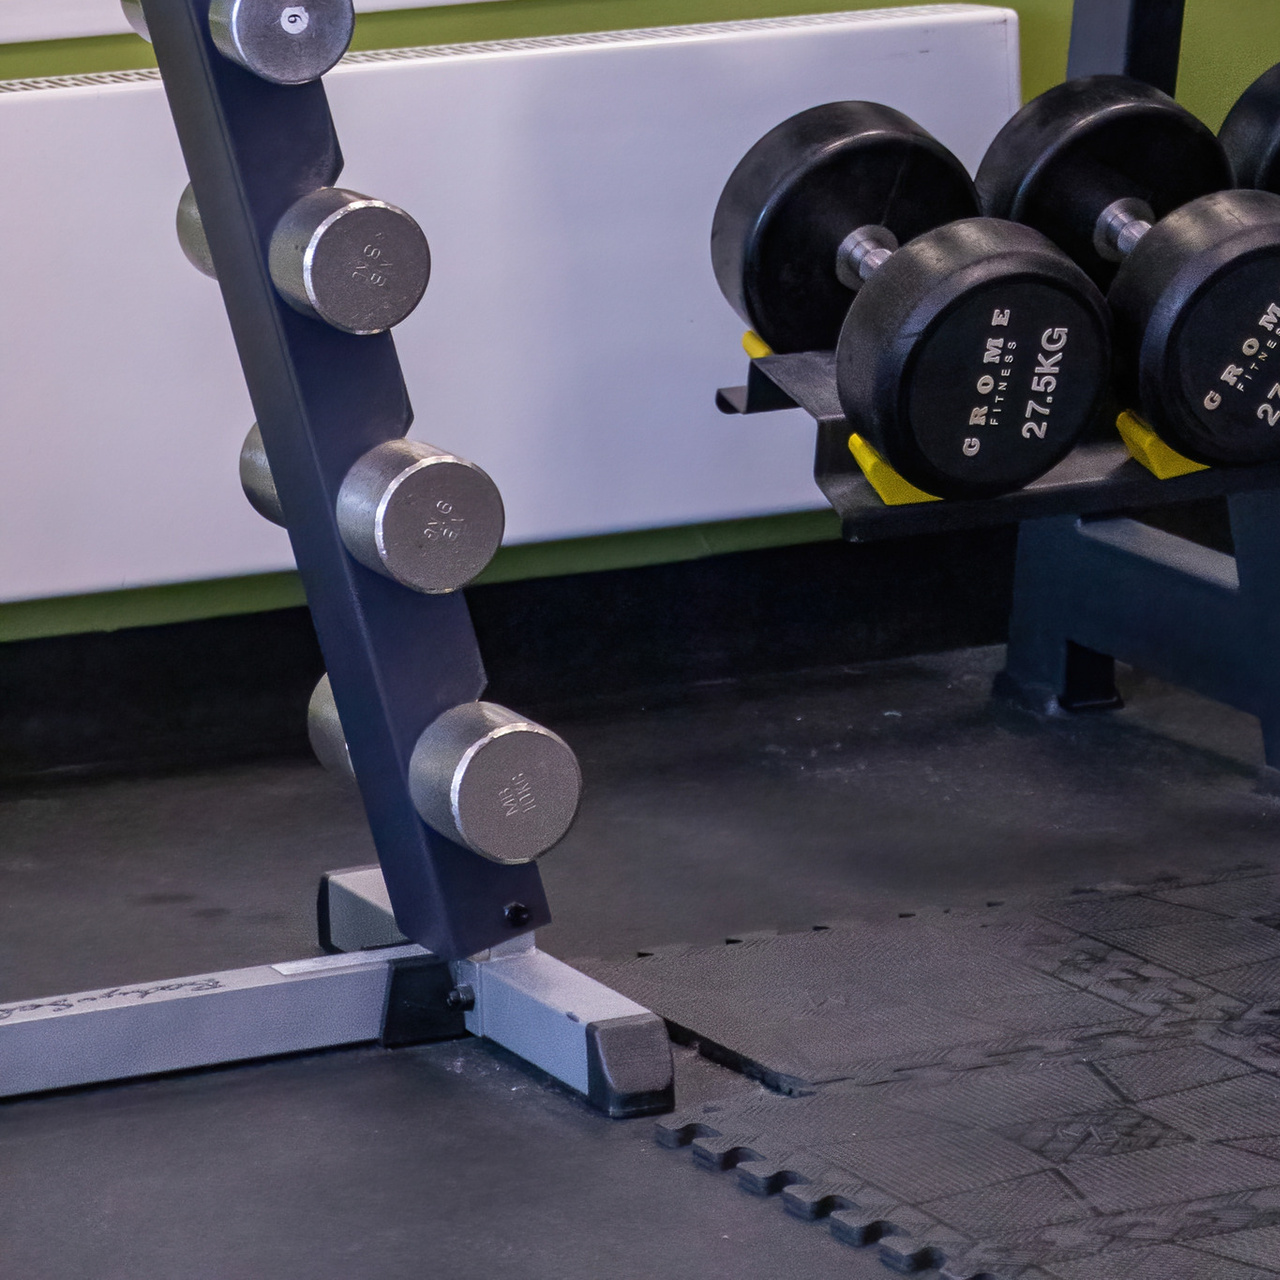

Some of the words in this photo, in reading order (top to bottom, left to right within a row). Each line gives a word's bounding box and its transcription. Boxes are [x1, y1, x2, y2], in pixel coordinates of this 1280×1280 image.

[962, 309, 1011, 457] GROME
[989, 341, 1017, 426] FITNESS
[1021, 327, 1069, 439] 27.5KG
